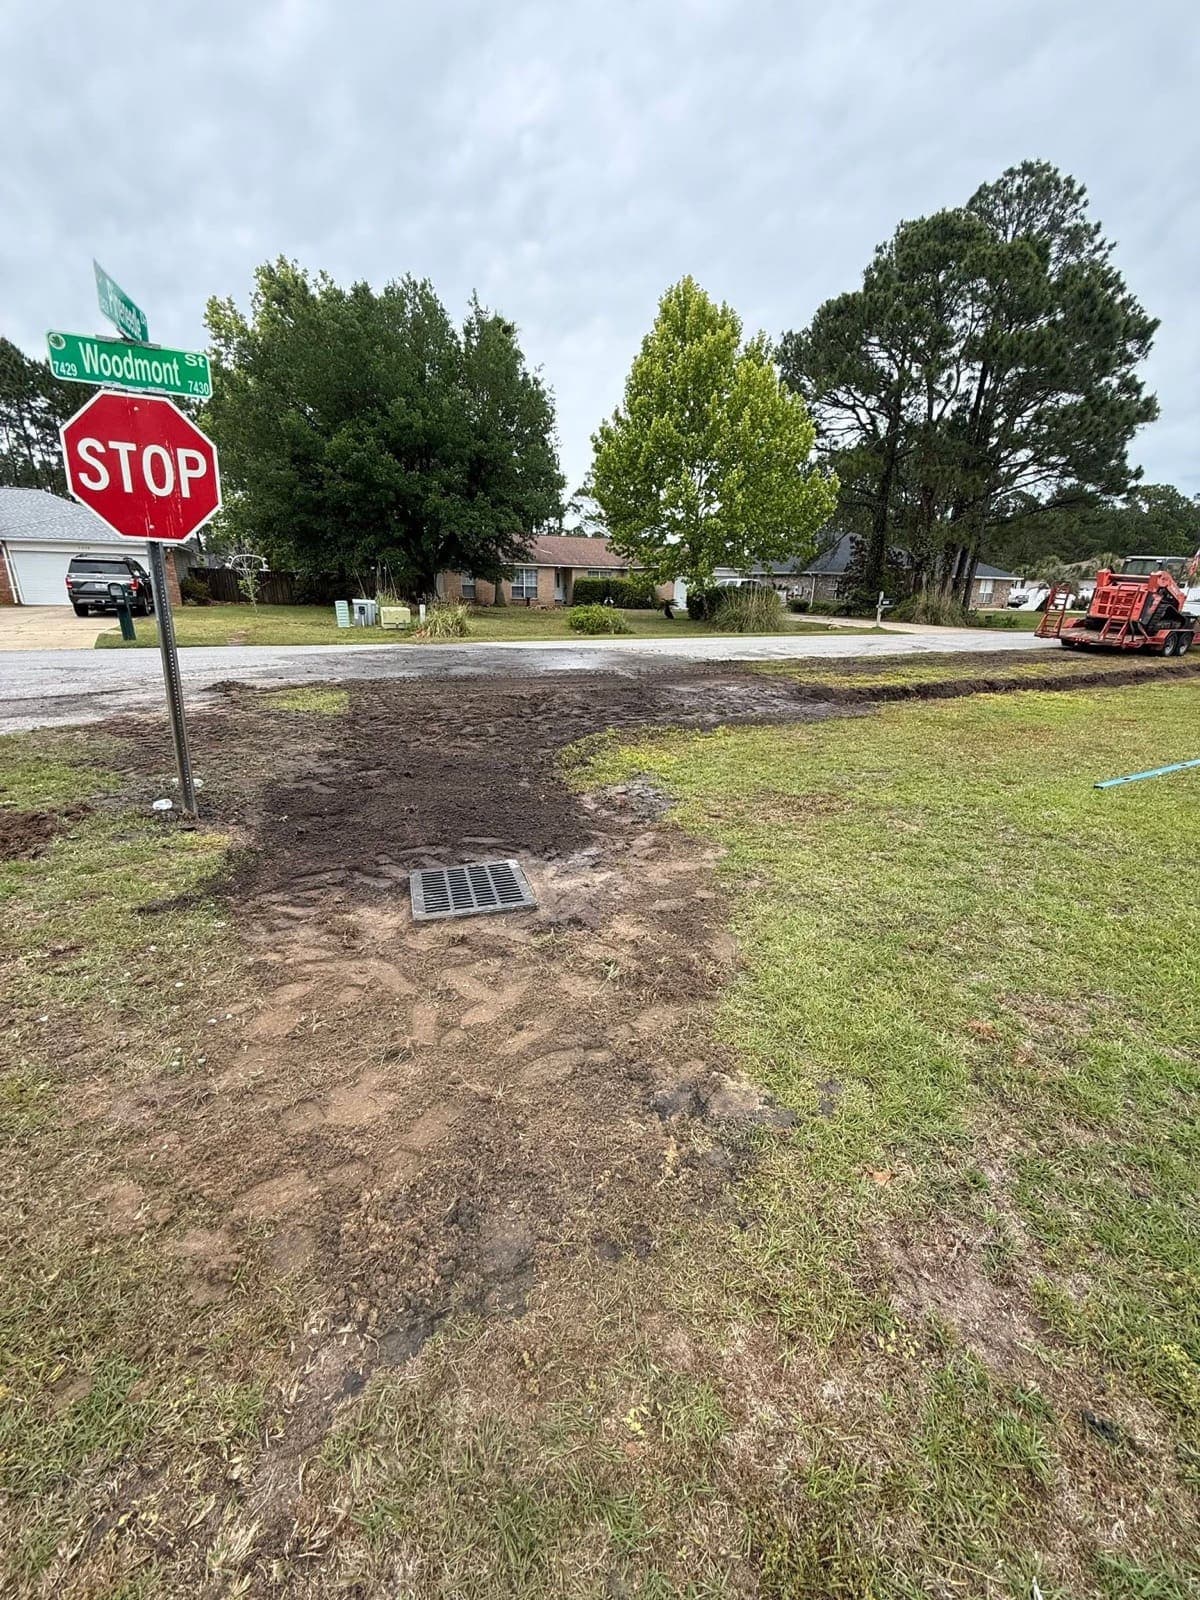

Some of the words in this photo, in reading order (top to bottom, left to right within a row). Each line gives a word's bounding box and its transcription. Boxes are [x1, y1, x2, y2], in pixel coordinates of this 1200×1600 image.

[53, 361, 78, 377] 7429
[78, 341, 181, 386] Woodmont
[184, 353, 205, 368] St
[188, 380, 209, 395] 7430
[77, 437, 207, 498] STOP
